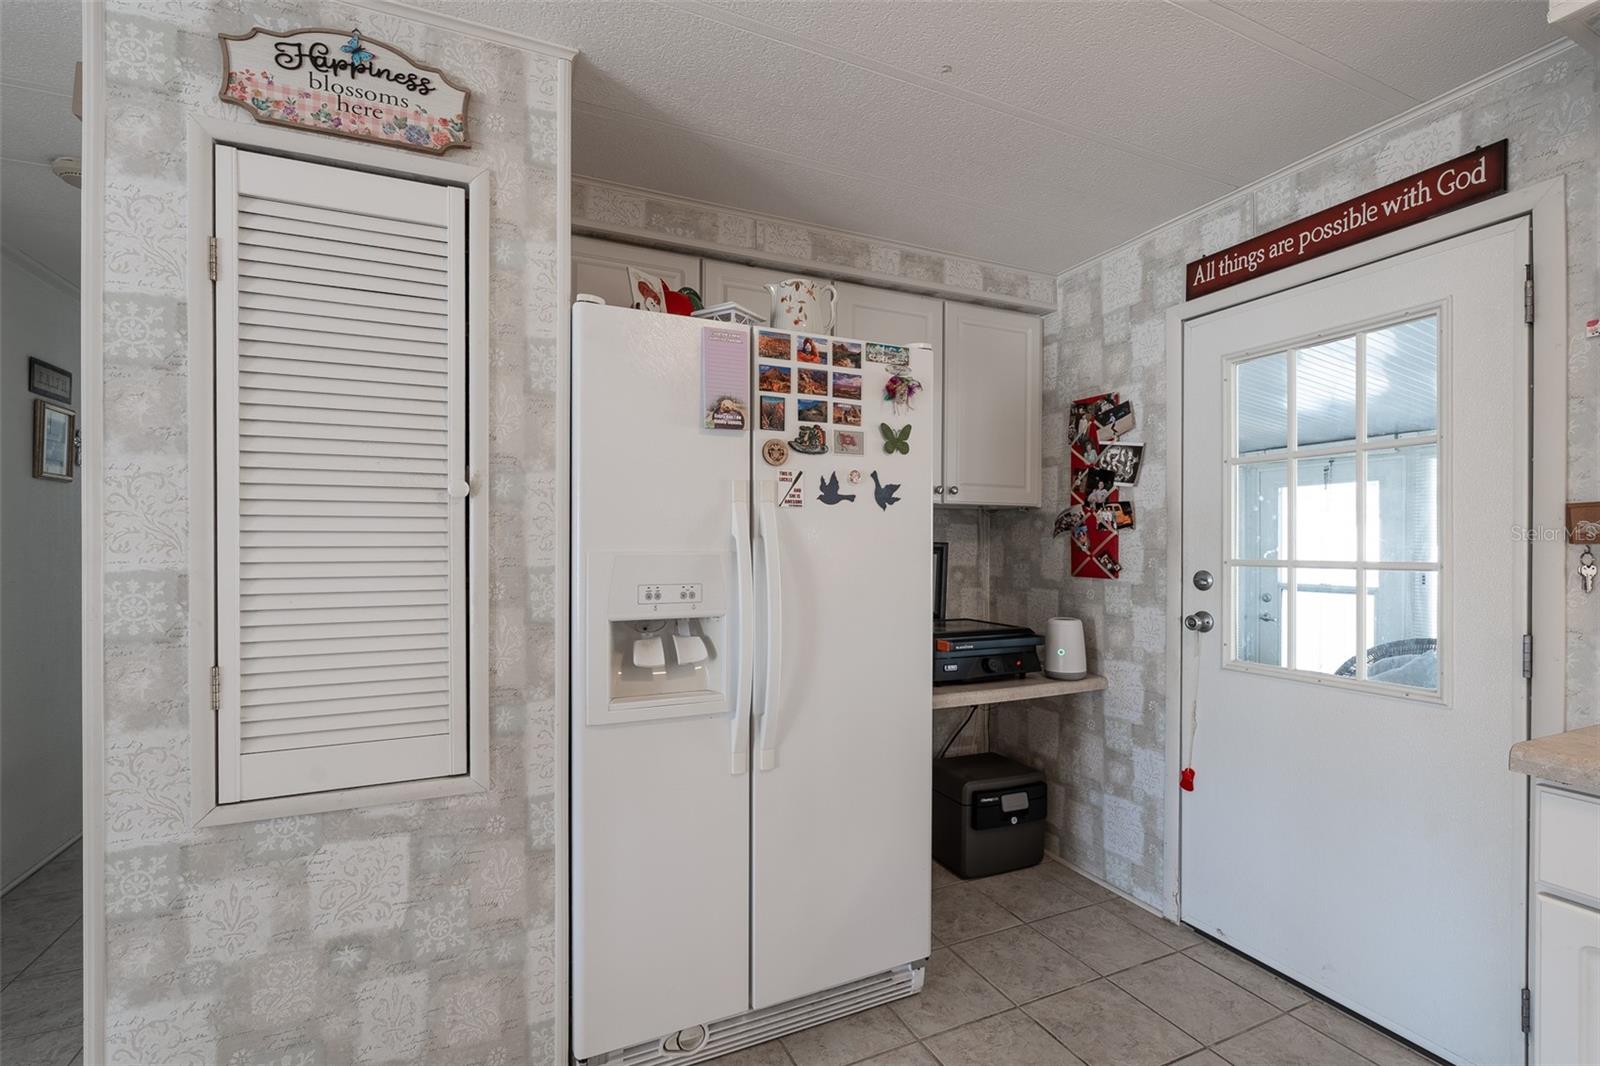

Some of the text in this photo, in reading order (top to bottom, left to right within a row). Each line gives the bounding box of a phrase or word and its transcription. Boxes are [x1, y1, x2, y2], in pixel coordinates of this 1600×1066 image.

[274, 41, 436, 96] Happiness
[309, 72, 409, 108] blossoms
[337, 95, 384, 120] here
[1193, 156, 1487, 286] All things are possible with God
